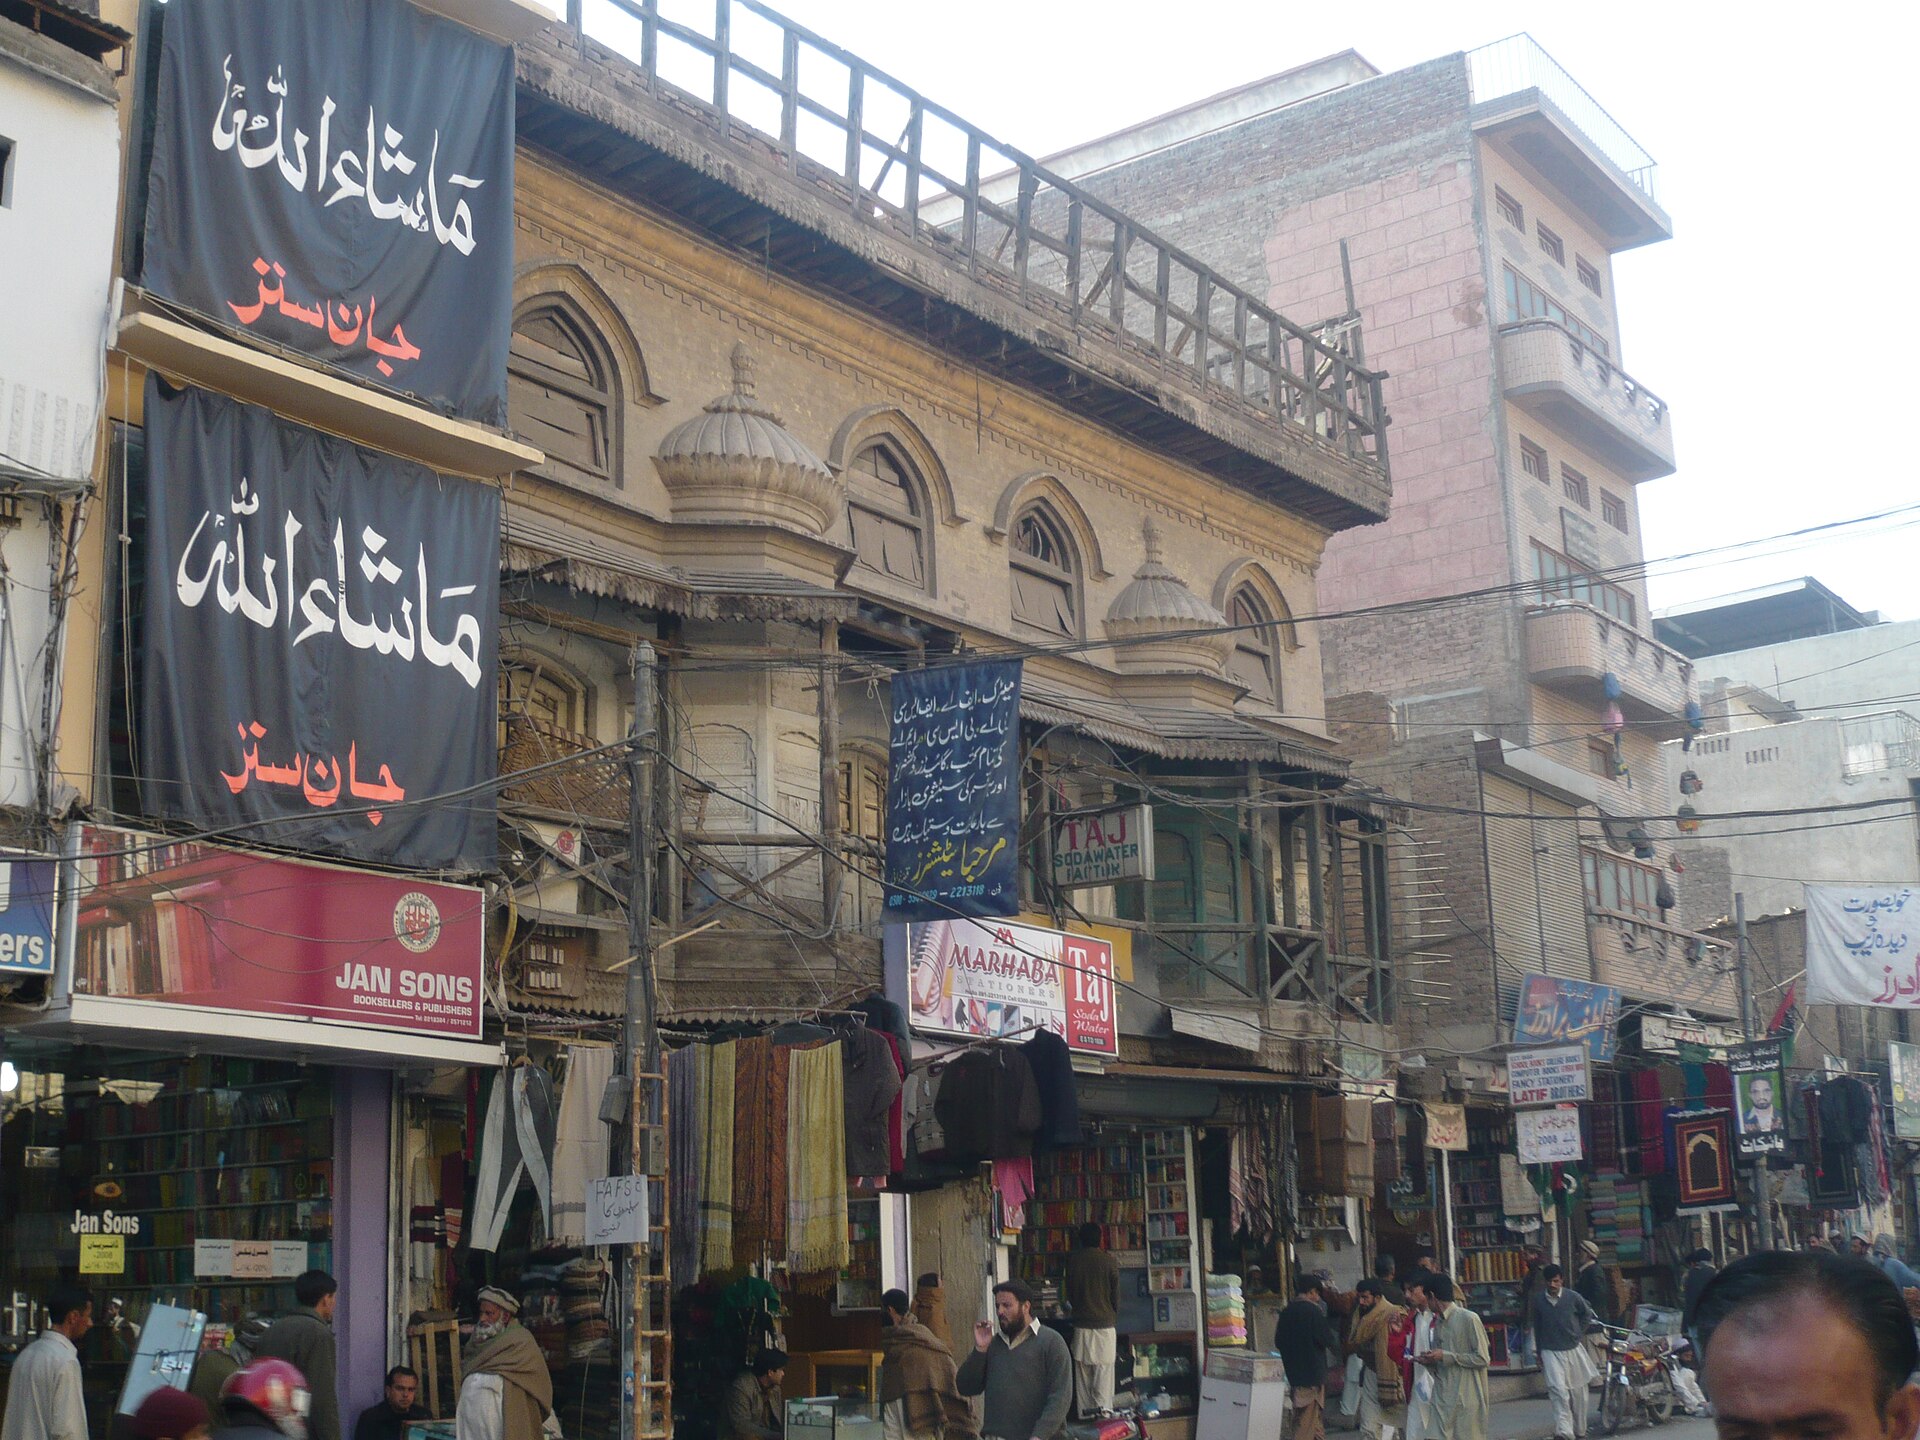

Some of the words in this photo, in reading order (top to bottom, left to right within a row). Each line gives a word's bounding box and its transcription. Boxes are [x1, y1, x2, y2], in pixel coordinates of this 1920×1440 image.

[1063, 813, 1127, 850] TAJ
[961, 837, 1007, 883] مرحبا
[1843, 889, 1912, 914] خوبصورت
[948, 943, 1060, 987] MARHABA
[335, 962, 391, 994] JAN
[399, 969, 473, 1003] SONS
[956, 975, 1056, 999] STATIONERS
[1068, 946, 1109, 1022] Taj
[353, 994, 413, 1010] BOOKSELLERS
[415, 1002, 421, 1011] &
[422, 1002, 472, 1016] PUBLISHERS
[1073, 1007, 1099, 1021] Soda
[1073, 1020, 1110, 1034] Water
[1512, 1088, 1548, 1104] LATIF
[70, 1208, 99, 1234] Jan
[102, 1209, 140, 1235] Sons
